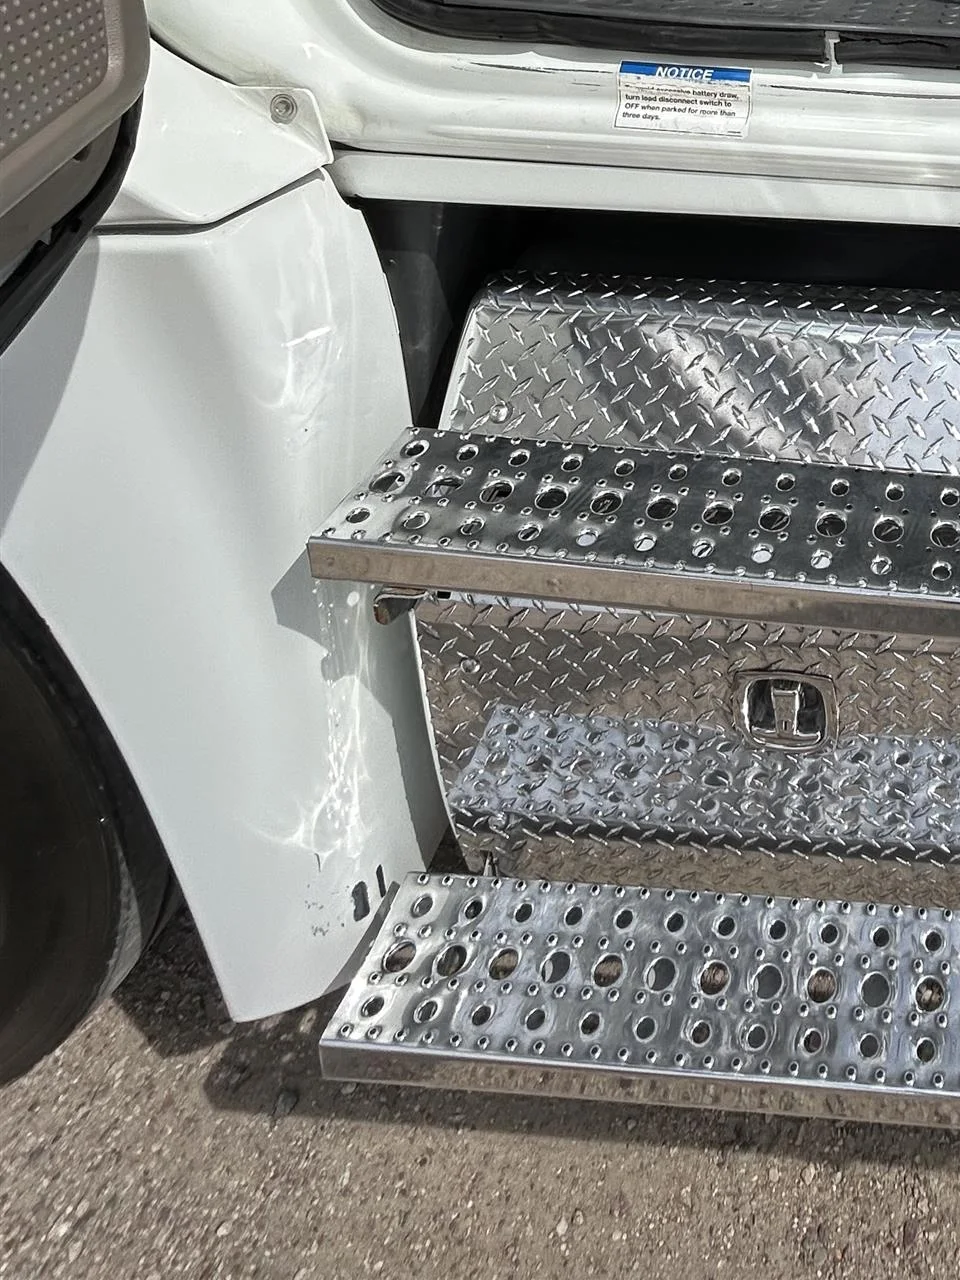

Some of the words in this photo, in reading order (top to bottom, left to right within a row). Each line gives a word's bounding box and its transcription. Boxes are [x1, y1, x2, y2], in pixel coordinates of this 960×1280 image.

[656, 66, 714, 81] NOTICE
[692, 89, 718, 99] battery
[625, 102, 640, 110] OFF
[658, 96, 698, 105] disconnect
[699, 99, 723, 107] switch
[724, 100, 732, 108] to
[622, 111, 641, 119] three
[642, 113, 661, 121] days.
